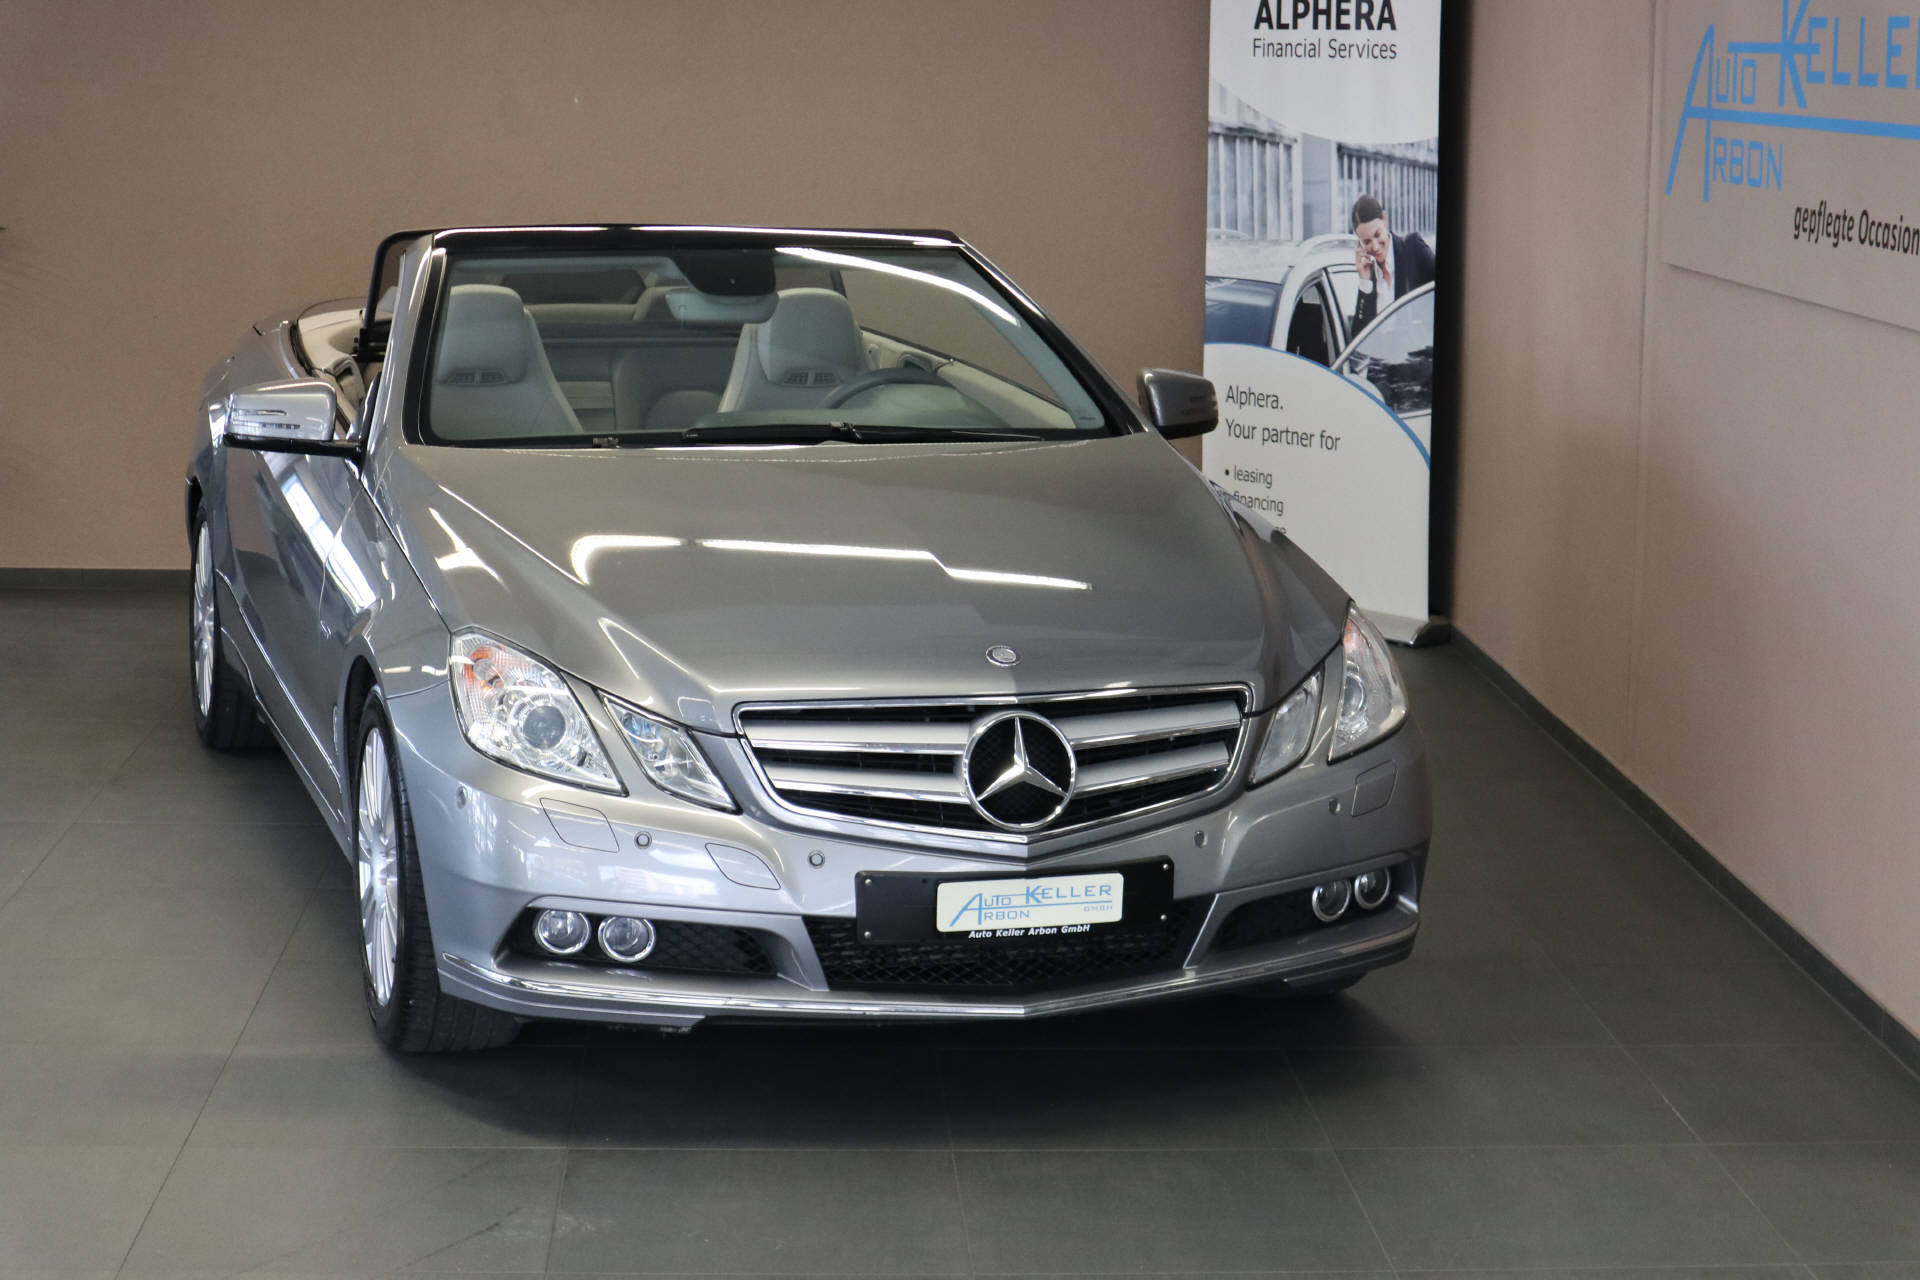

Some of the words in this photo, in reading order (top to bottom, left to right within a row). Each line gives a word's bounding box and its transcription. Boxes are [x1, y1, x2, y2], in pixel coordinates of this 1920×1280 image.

[1253, 0, 1397, 31] ALPHERA
[1253, 38, 1321, 59] Financial
[1327, 38, 1397, 60] Services
[1774, 0, 1920, 109] KELLE
[1665, 108, 1783, 203] ARBON
[1793, 199, 1855, 248] gepflegte
[1225, 385, 1284, 410] Alphera.
[1225, 418, 1257, 440] Your
[1261, 426, 1315, 448] partner
[1319, 429, 1341, 451] for
[1233, 464, 1273, 489] leasing
[1025, 884, 1112, 904] KELLER
[949, 901, 1030, 927] ARBON
[968, 929, 992, 939] Auto
[995, 928, 1025, 938] Keller
[1028, 926, 1057, 936] Arbon
[1061, 924, 1091, 934] GmbH
